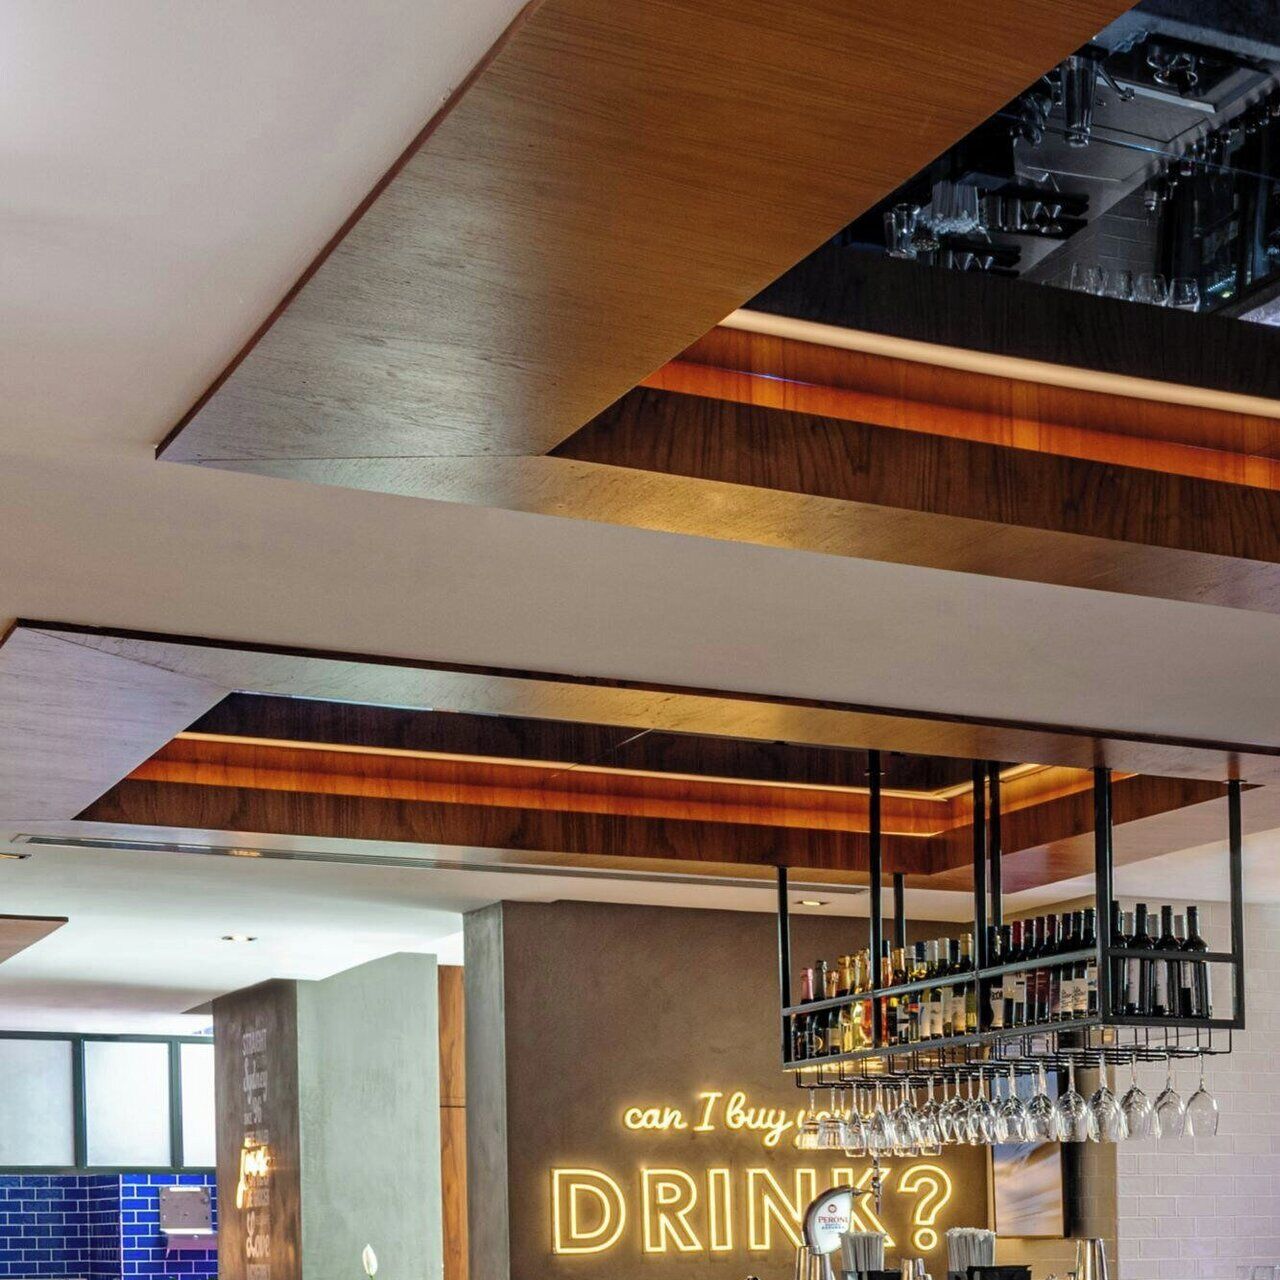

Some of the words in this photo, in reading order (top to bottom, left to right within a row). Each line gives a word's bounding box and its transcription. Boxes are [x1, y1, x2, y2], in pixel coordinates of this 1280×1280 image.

[623, 1102, 687, 1132] can
[693, 1090, 723, 1133] I
[725, 1090, 793, 1148] buy
[550, 1163, 954, 1256] DRINK?
